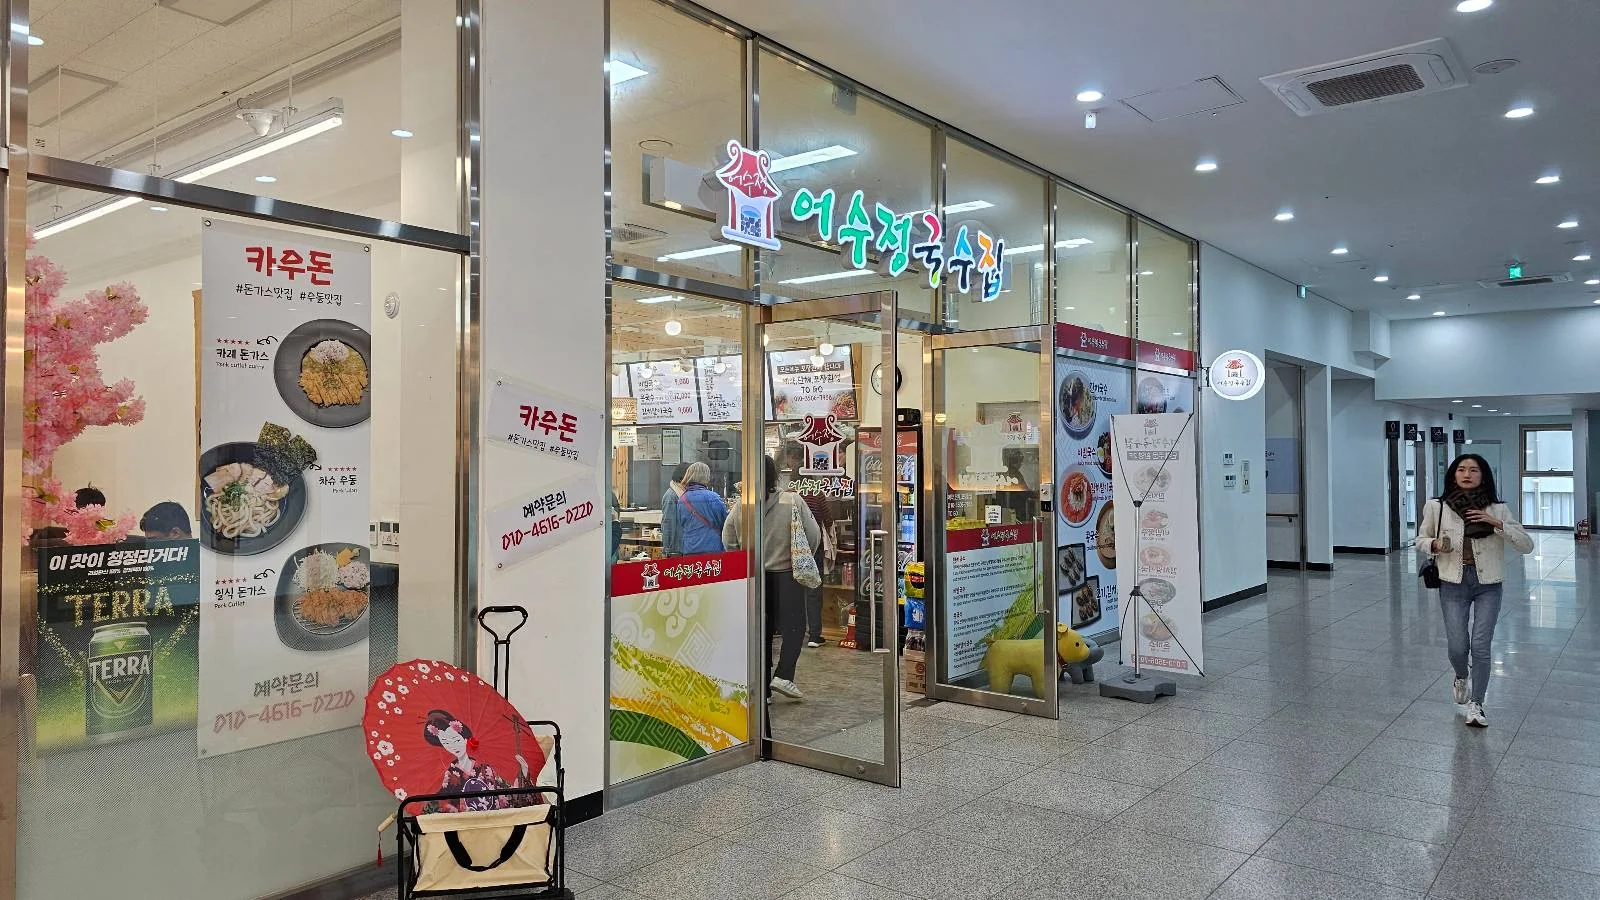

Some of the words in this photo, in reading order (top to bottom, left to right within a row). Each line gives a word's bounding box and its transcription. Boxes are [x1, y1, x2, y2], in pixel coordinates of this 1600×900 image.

[728, 167, 768, 196] 어수정
[791, 187, 1004, 302] 어수정국수집
[236, 284, 294, 300] #돈가스맛집
[300, 293, 343, 306] #우동맛집
[216, 348, 237, 360] 카레
[240, 349, 269, 361] 돈가스
[507, 433, 546, 452] #돈가스맛집
[549, 445, 580, 461] #우동맛집
[319, 475, 337, 487] 차슈
[340, 474, 358, 487] 우동
[788, 477, 855, 497] 어수정국수집
[523, 491, 567, 518] 예약문의
[502, 501, 594, 551] 010-4616-0220
[50, 554, 67, 571] 이
[69, 551, 104, 569] 맛이
[108, 546, 189, 567] 청정라거다!
[664, 559, 722, 581] 어수정국수집
[214, 586, 234, 600] 일식
[237, 585, 267, 598] 돈가스
[65, 586, 175, 628] TERRA
[90, 655, 151, 682] TERRA
[253, 671, 319, 698] 예약문의
[213, 690, 356, 734] 010-4616-0220
